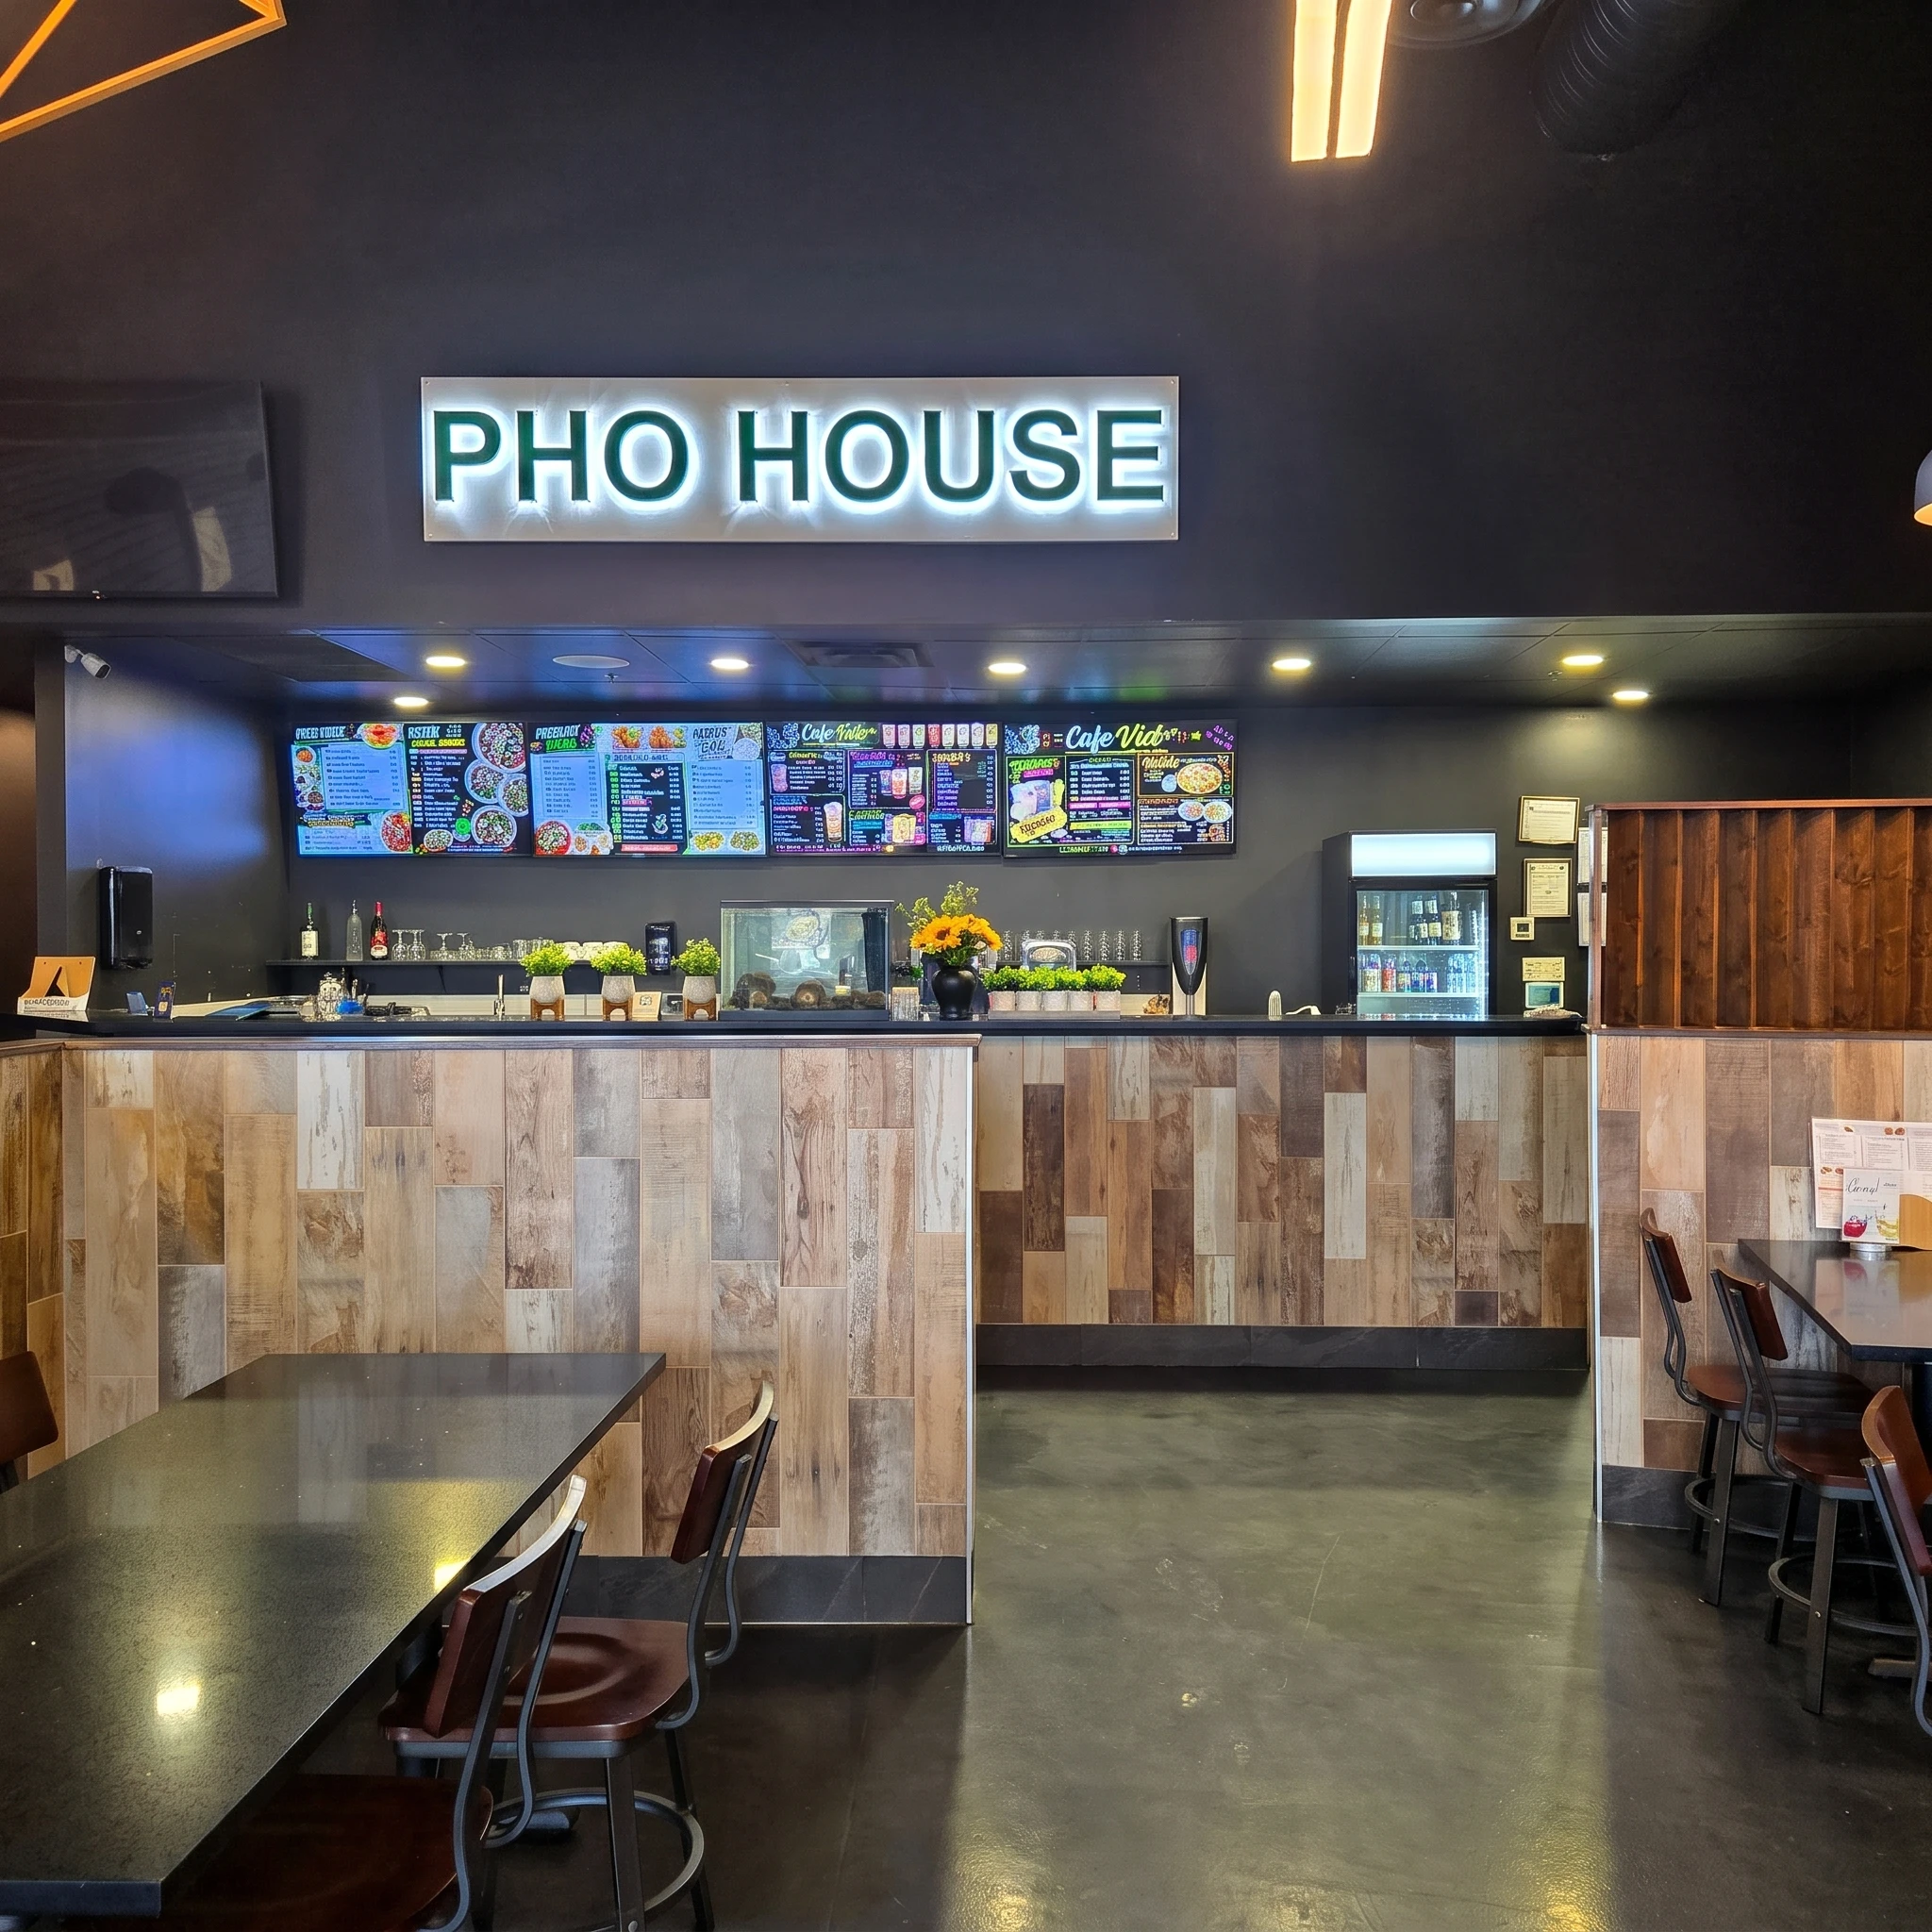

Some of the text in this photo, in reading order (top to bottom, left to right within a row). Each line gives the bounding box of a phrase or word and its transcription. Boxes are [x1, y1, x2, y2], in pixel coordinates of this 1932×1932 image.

[431, 408, 1165, 502] PHO HOUSE
[1065, 724, 1115, 754] Cafe
